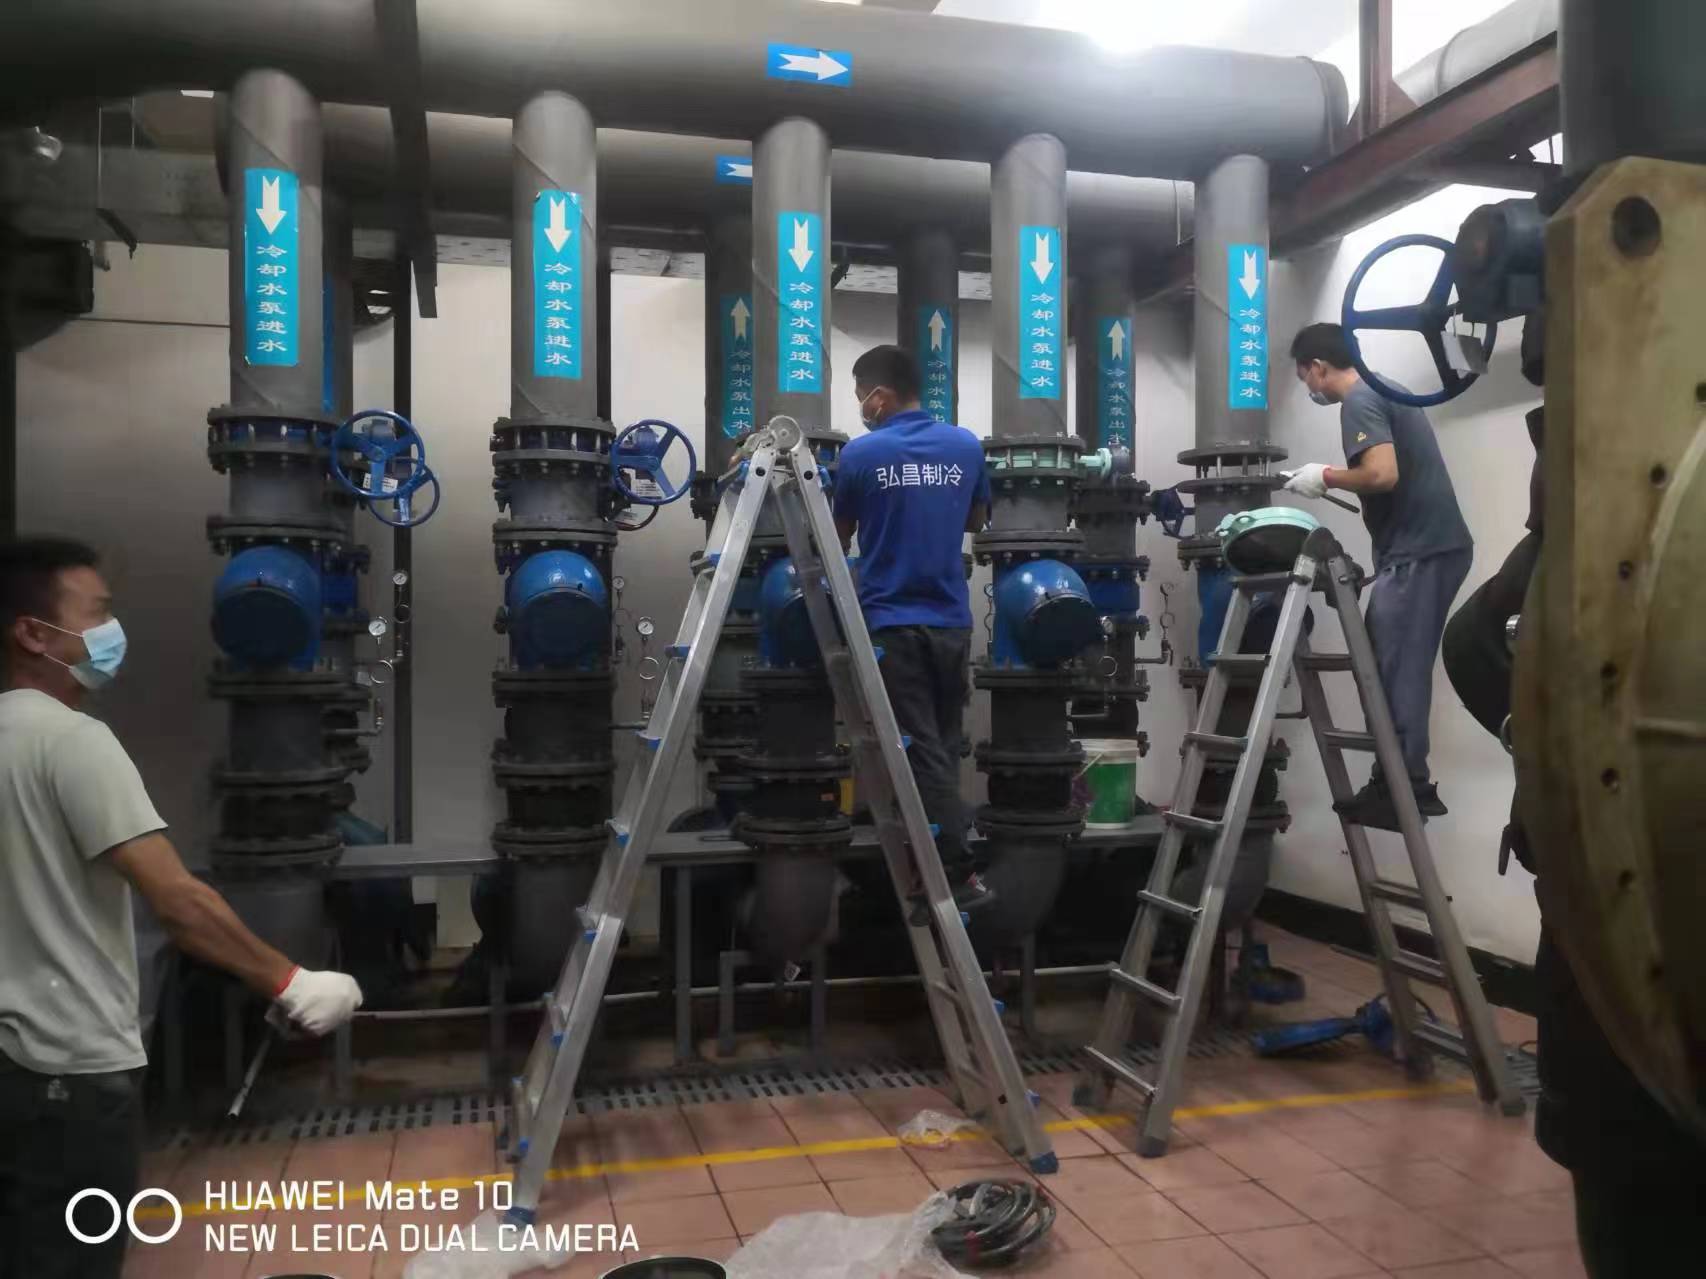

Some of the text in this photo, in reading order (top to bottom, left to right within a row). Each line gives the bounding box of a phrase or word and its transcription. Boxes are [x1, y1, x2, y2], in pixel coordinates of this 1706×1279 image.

[256, 244, 288, 352] 冷却水泵进水
[544, 263, 572, 365] 冷却水泵进水
[790, 281, 815, 380] 冷却水泵进水
[1031, 292, 1055, 388] 冷却水泵进水
[730, 348, 752, 430] 冷却水泵出水
[1239, 308, 1262, 398] 冷却水泵进水
[876, 463, 963, 489] 弘昌制冷
